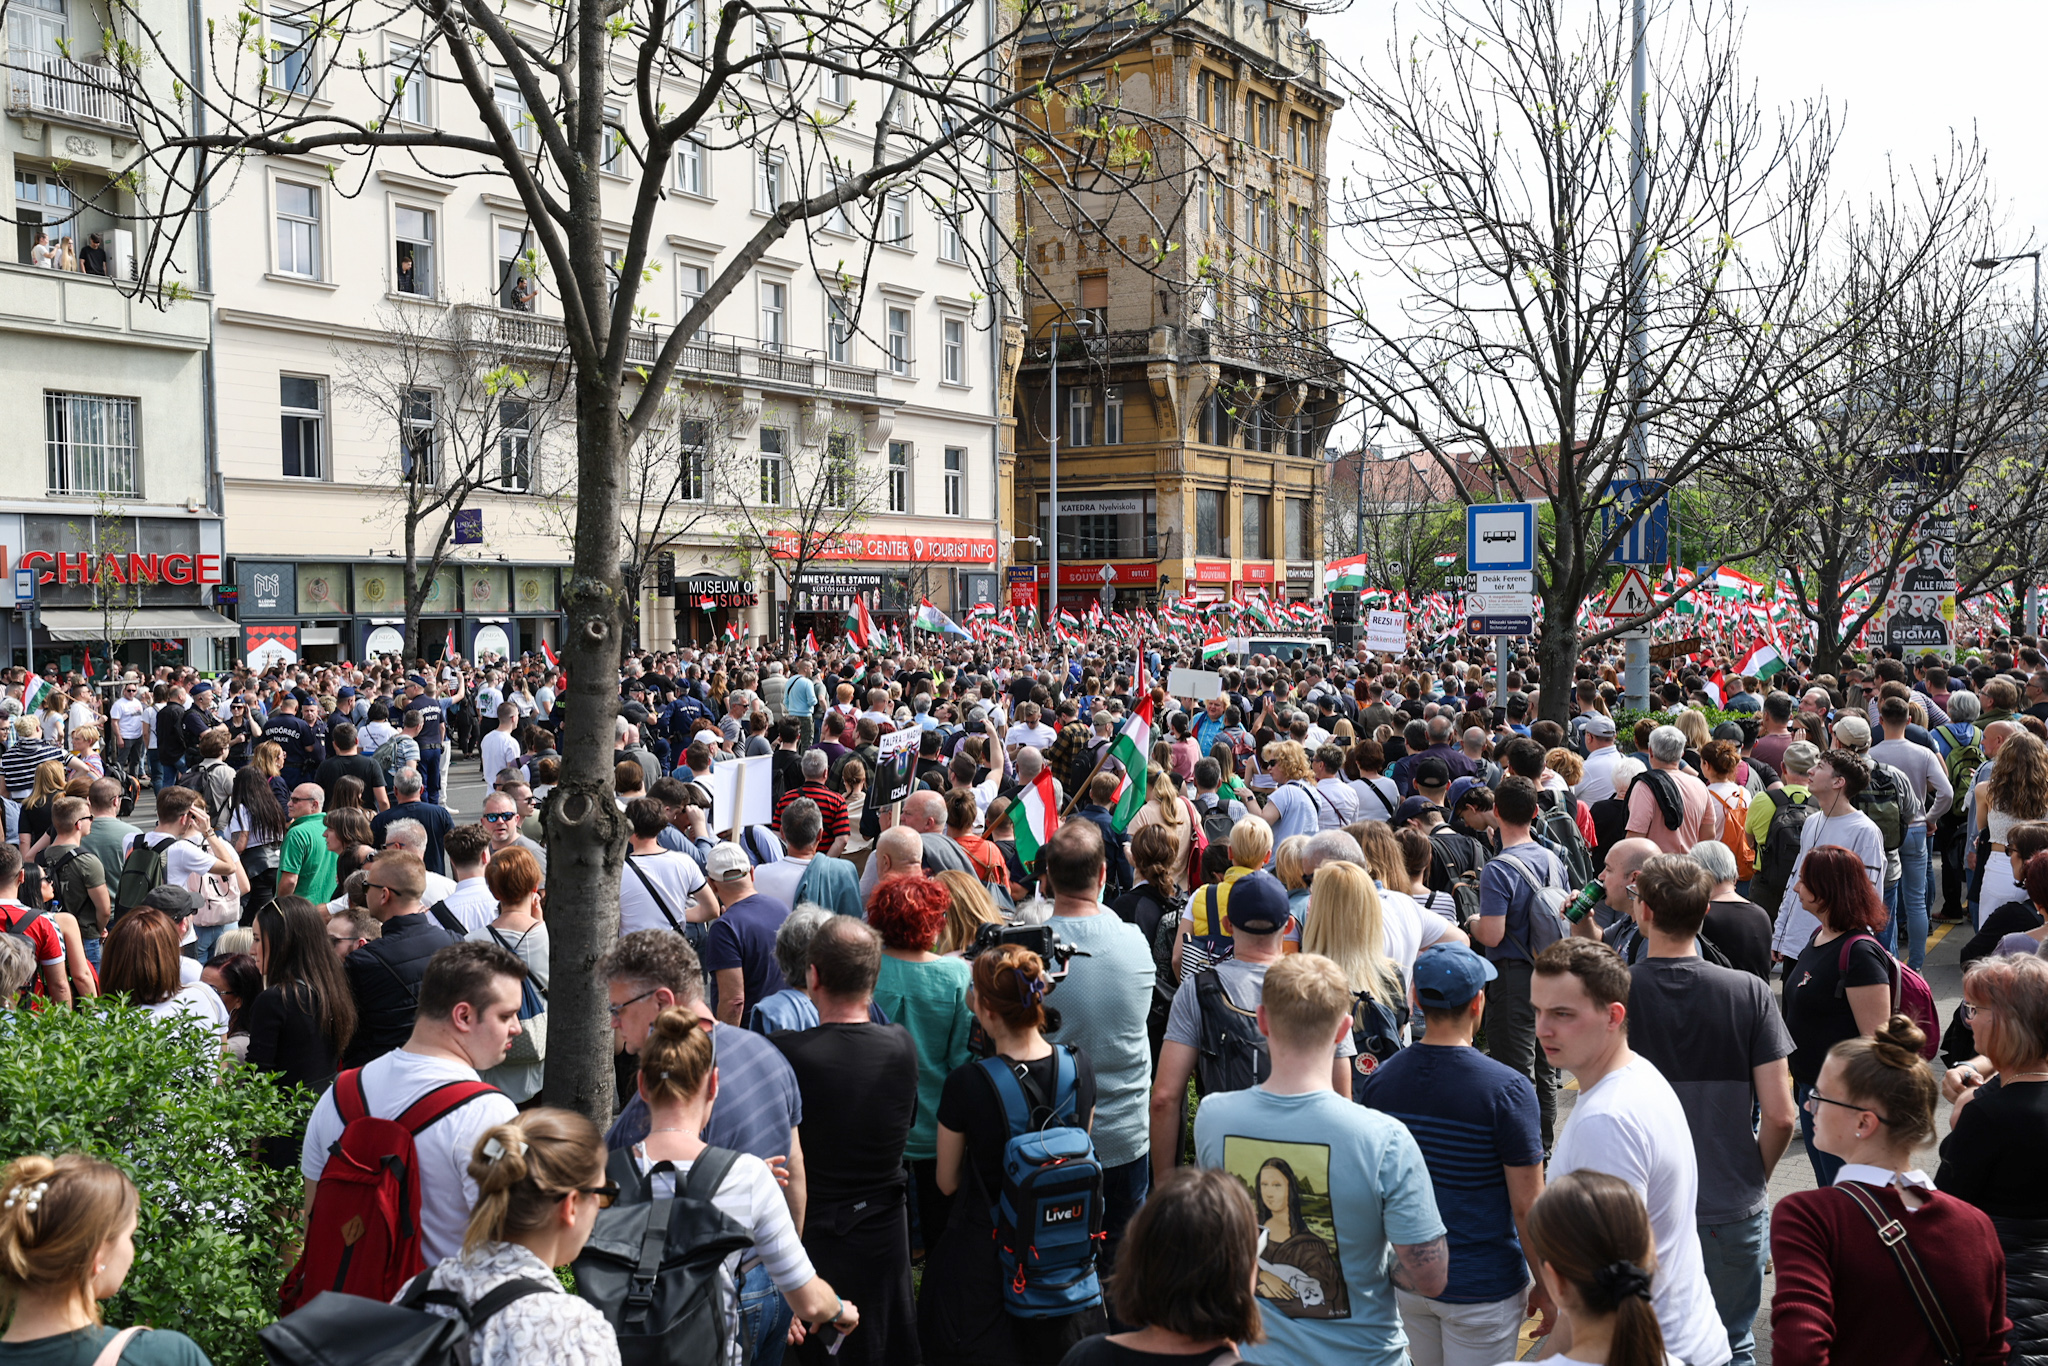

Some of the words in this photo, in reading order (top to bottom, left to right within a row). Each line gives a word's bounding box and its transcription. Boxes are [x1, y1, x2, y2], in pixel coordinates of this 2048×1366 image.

[1099, 502, 1136, 512] Nyelviskola
[778, 537, 798, 553] THE
[868, 540, 909, 556] CENTER
[928, 543, 968, 557] TOURIST
[970, 544, 995, 558] INFO
[20, 550, 222, 584] CHANGE
[849, 576, 880, 584] STATION
[689, 580, 739, 594] MUSEUM
[1914, 581, 1934, 590] ALLE
[1373, 616, 1392, 625] REZSI
[1892, 630, 1941, 639] SIGMA
[890, 784, 908, 800] IZSÁK
